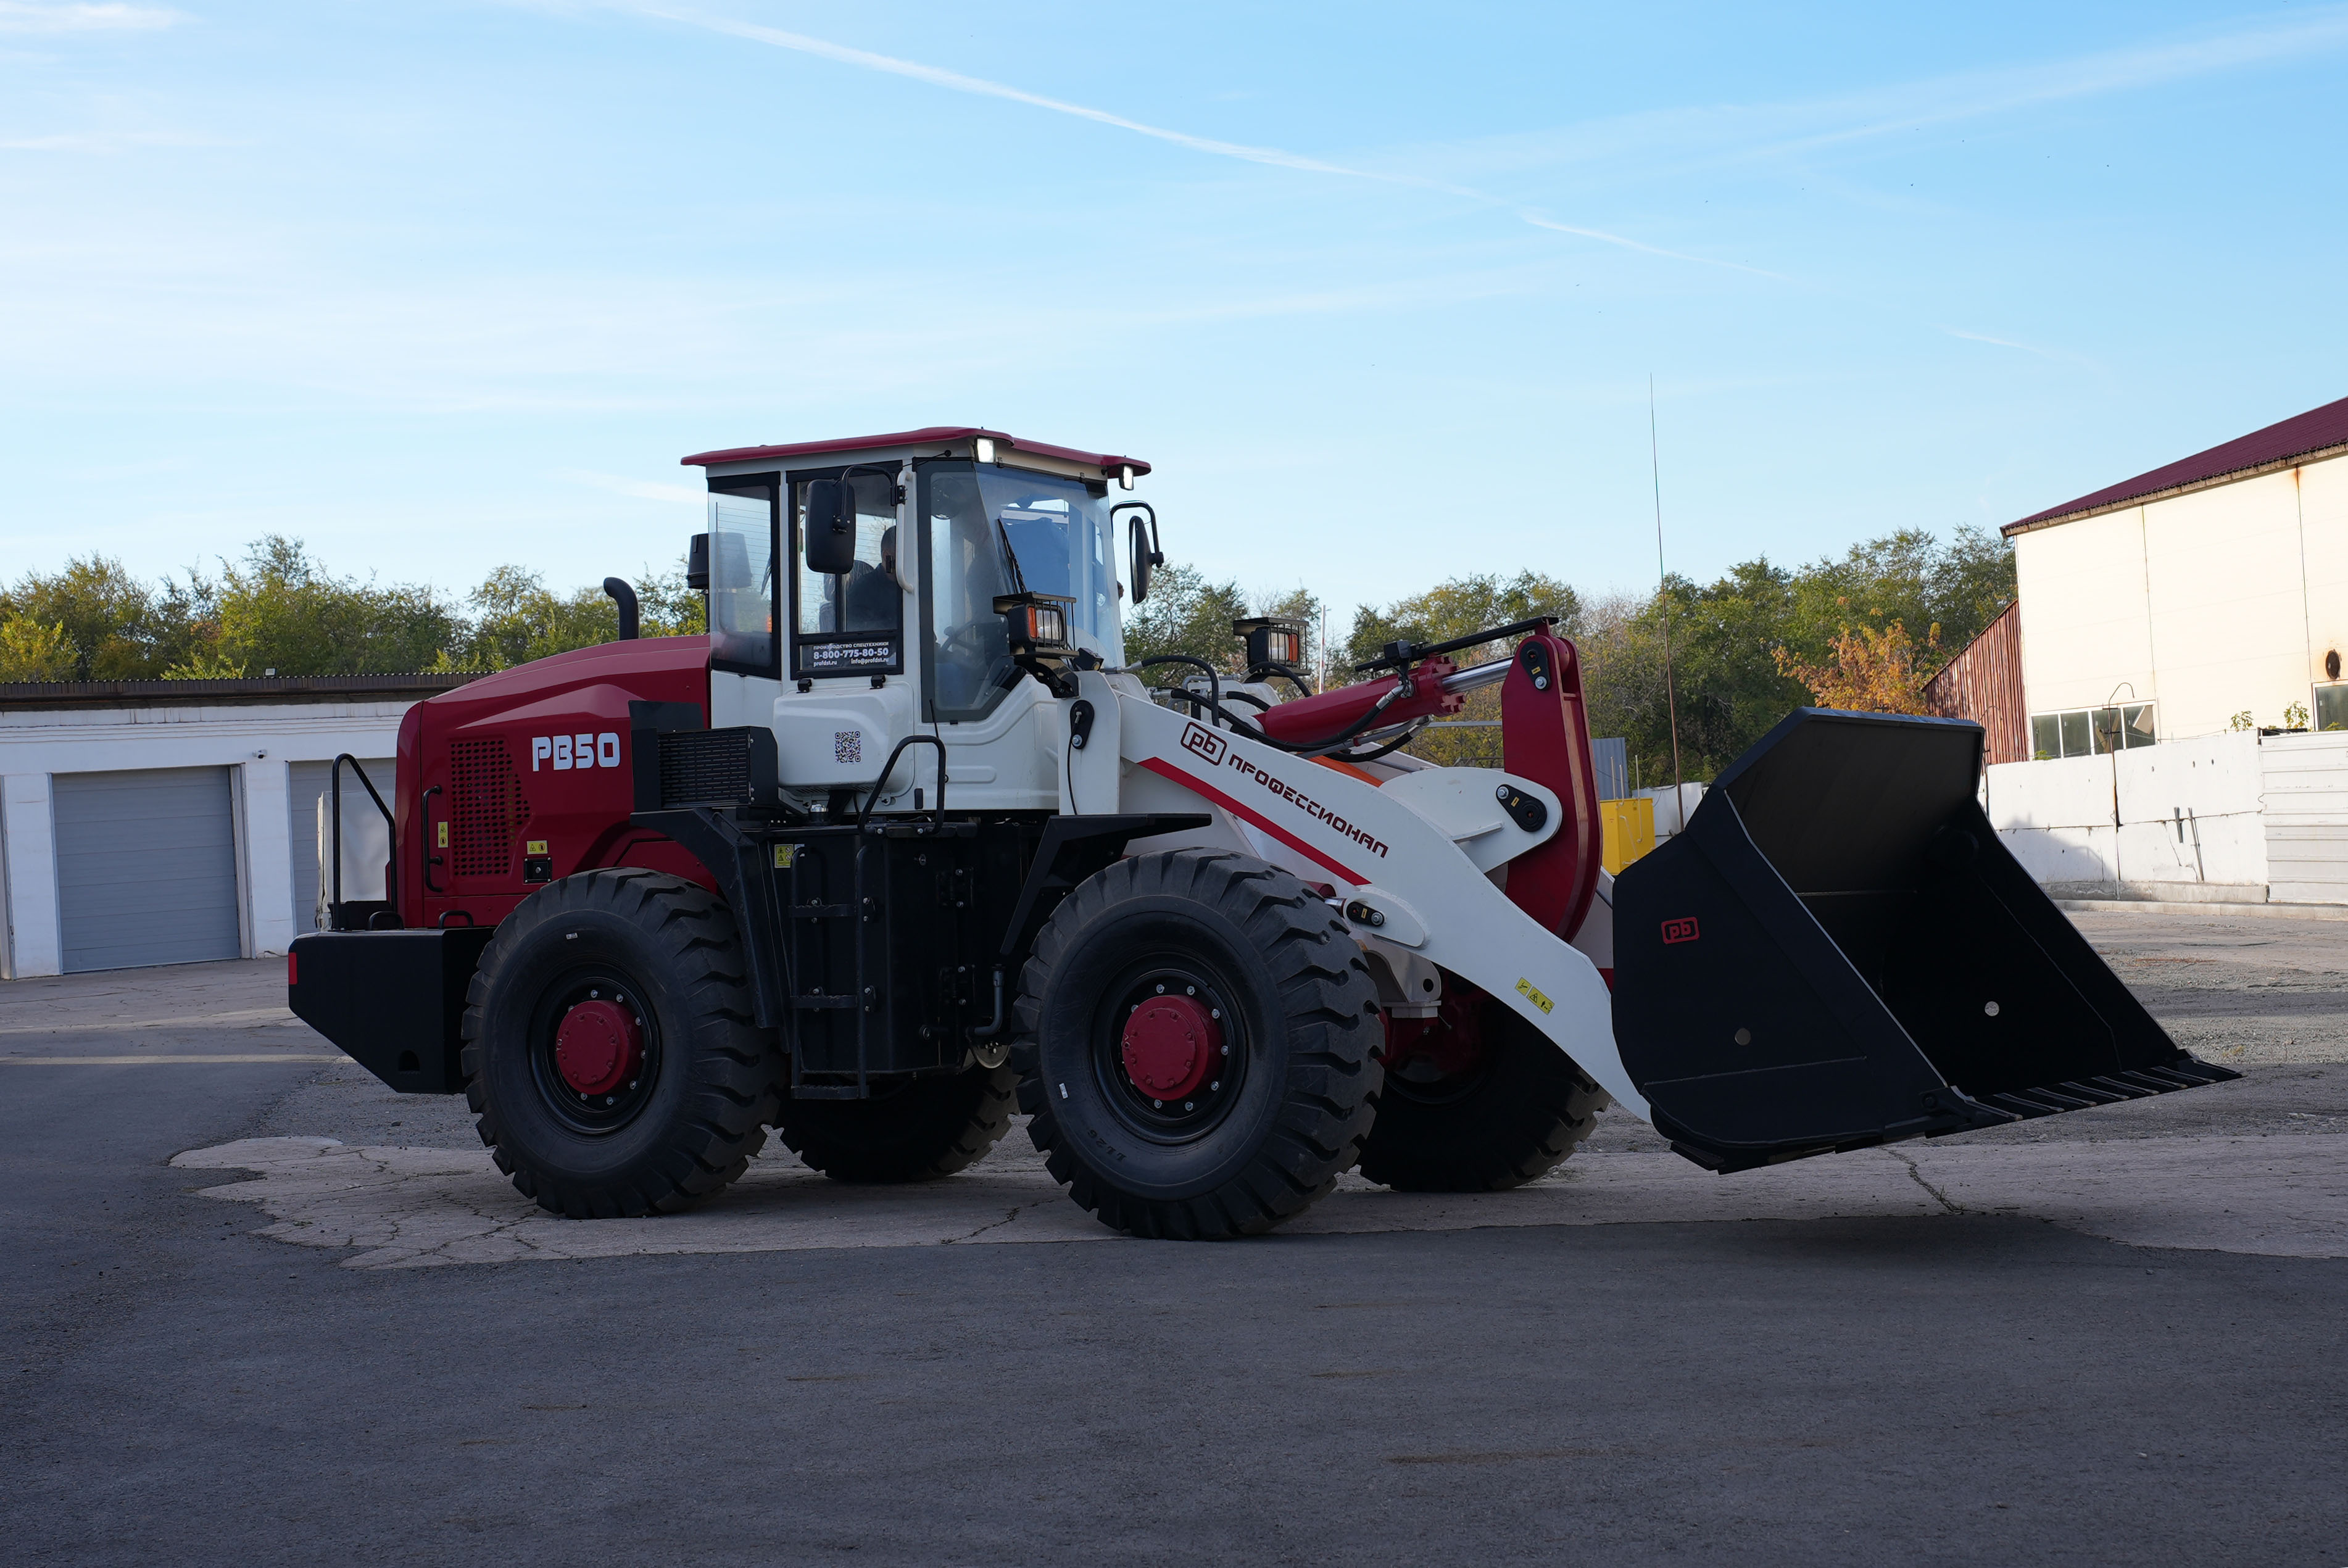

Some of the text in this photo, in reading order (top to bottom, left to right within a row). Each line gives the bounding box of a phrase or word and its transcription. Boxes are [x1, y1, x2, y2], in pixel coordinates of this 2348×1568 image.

[813, 647, 889, 660] 8-800-775-80-50
[531, 732, 621, 772] PB50
[1227, 753, 1389, 858] ПРОФЕССИОНАЛ
